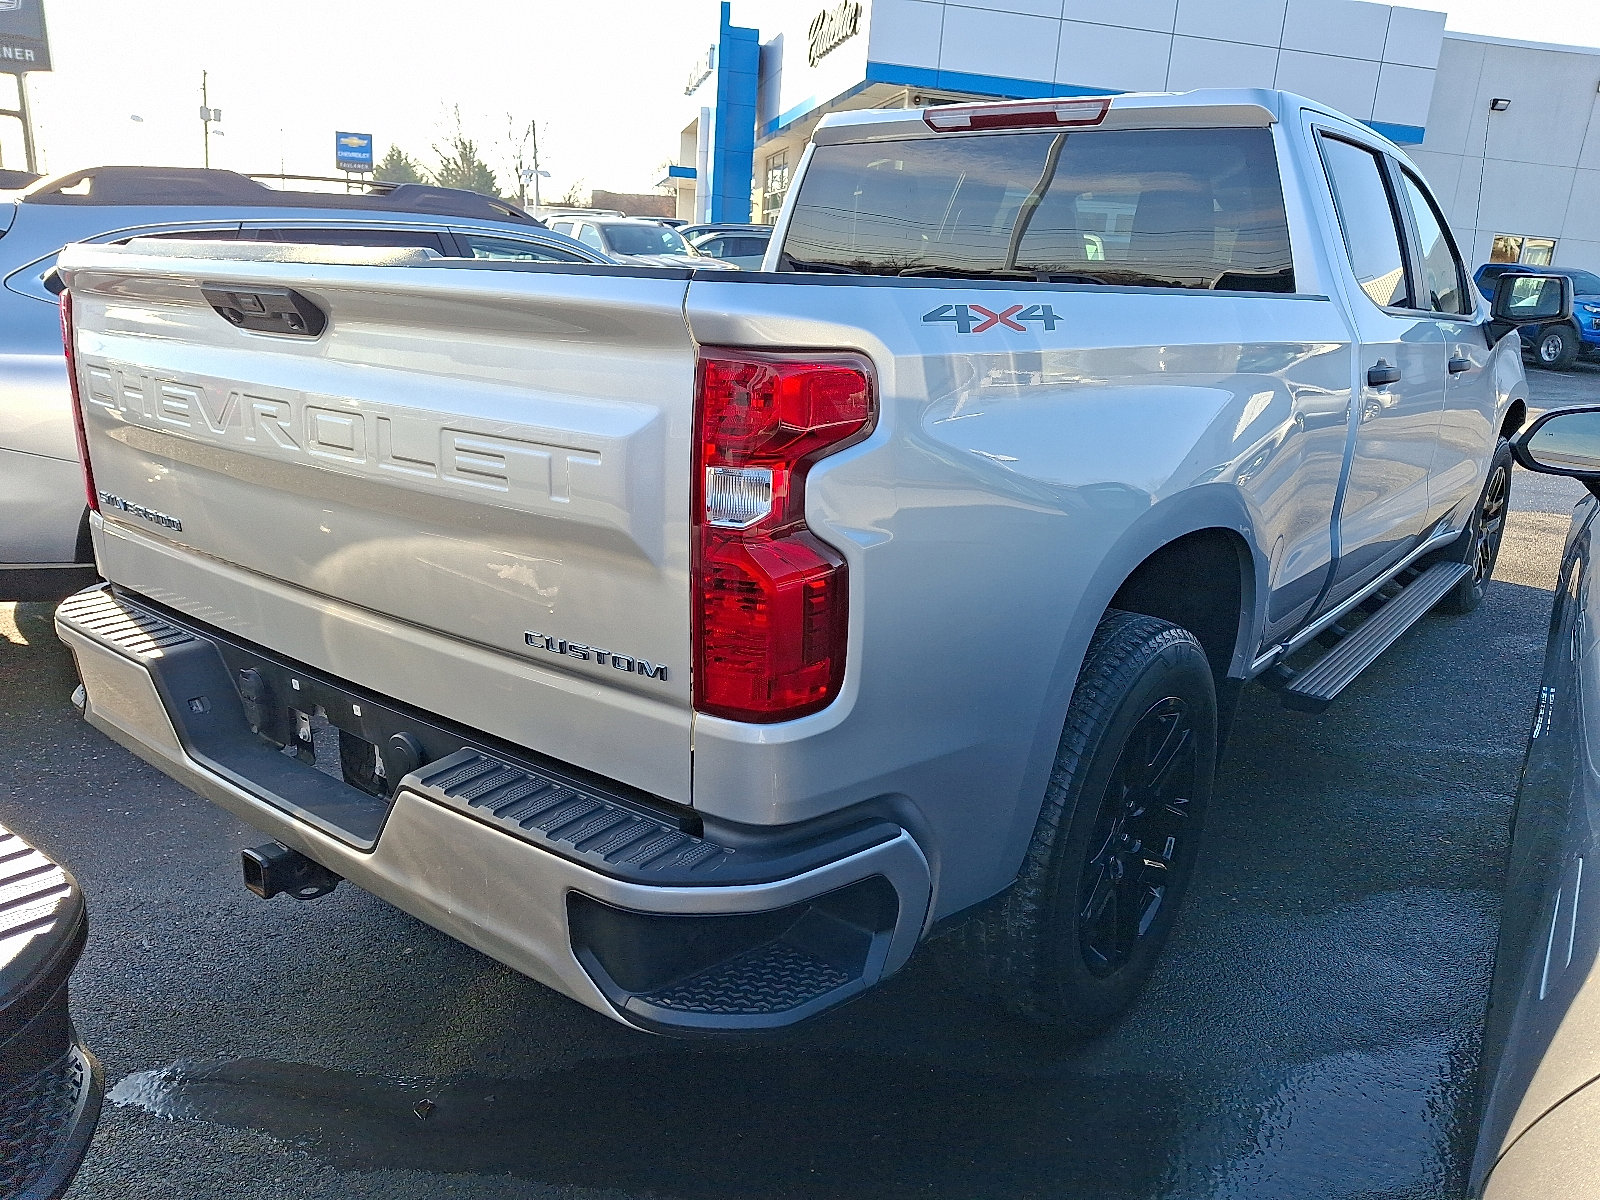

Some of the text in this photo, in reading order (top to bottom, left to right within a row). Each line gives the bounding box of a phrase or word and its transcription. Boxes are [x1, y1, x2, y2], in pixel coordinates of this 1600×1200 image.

[0, 46, 35, 61] NER
[86, 362, 604, 504] CHEVROLET
[99, 490, 183, 532] SILVERADO
[524, 629, 668, 681] CUSTOM
